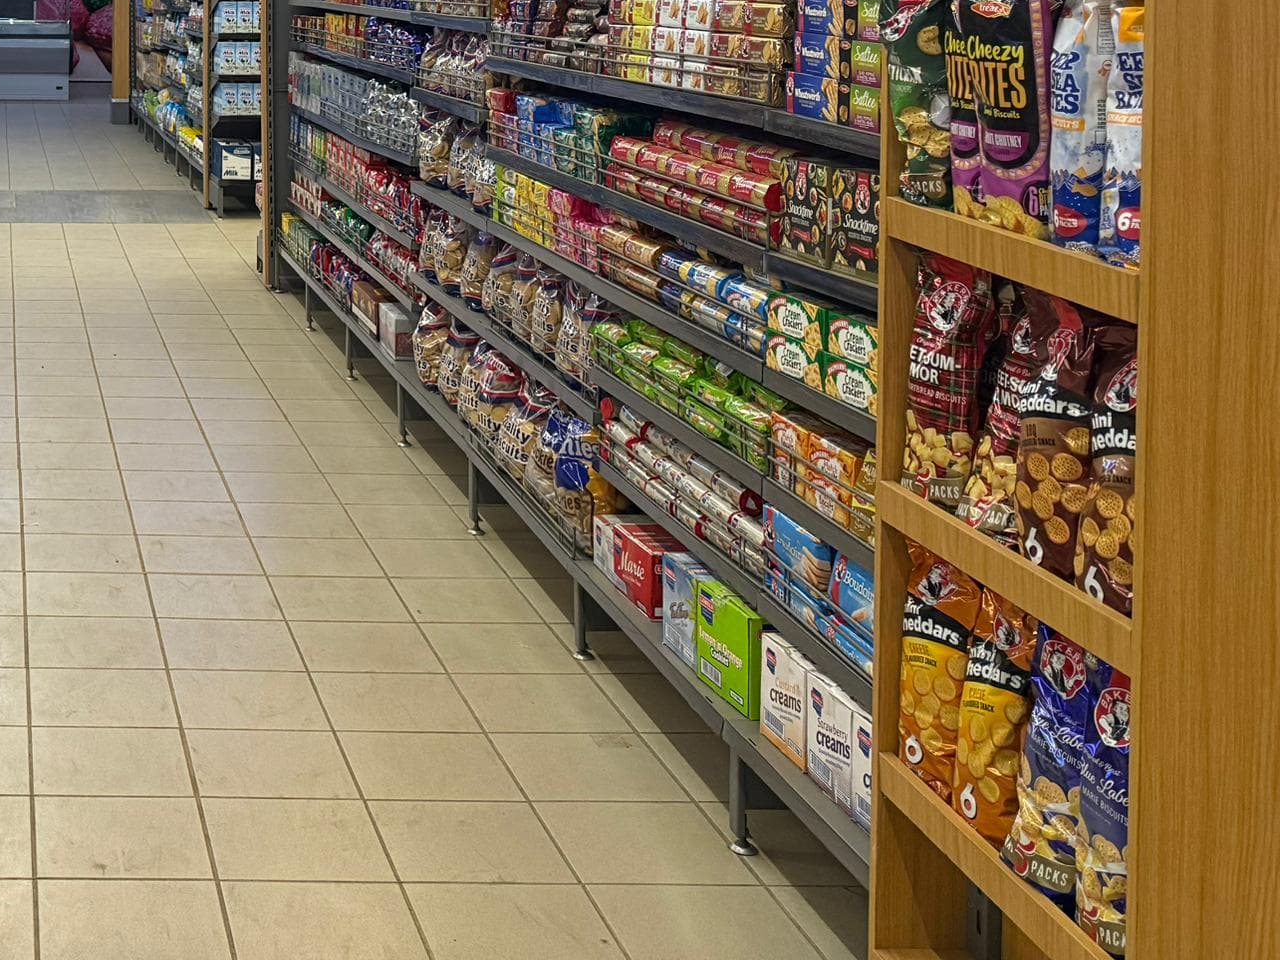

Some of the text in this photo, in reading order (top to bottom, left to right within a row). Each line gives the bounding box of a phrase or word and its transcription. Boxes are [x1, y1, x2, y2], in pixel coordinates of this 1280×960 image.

[967, 35, 1025, 69] Cheezy
[842, 213, 879, 235] Snacktime
[1117, 211, 1132, 232] 6
[782, 316, 803, 332] Crackers
[785, 308, 801, 321] Cream
[844, 340, 866, 357] Crackers
[846, 331, 865, 345] Cream
[780, 355, 802, 371] Crackers
[783, 347, 800, 359] Cream
[844, 375, 864, 390] Cream
[909, 361, 940, 386] MOR
[842, 383, 866, 401] Crackers
[934, 390, 968, 406] BISCUITS
[930, 484, 960, 500] PACKS
[1026, 527, 1044, 566] 6
[618, 551, 646, 580] Marie
[1084, 566, 1104, 602] 6
[1042, 641, 1085, 678] BAKERS
[770, 687, 803, 714] creams
[816, 729, 851, 760] creams
[904, 735, 924, 765] 6
[960, 783, 978, 820] 6
[1100, 799, 1130, 828] BISCUITS
[1030, 859, 1070, 888] PACKS
